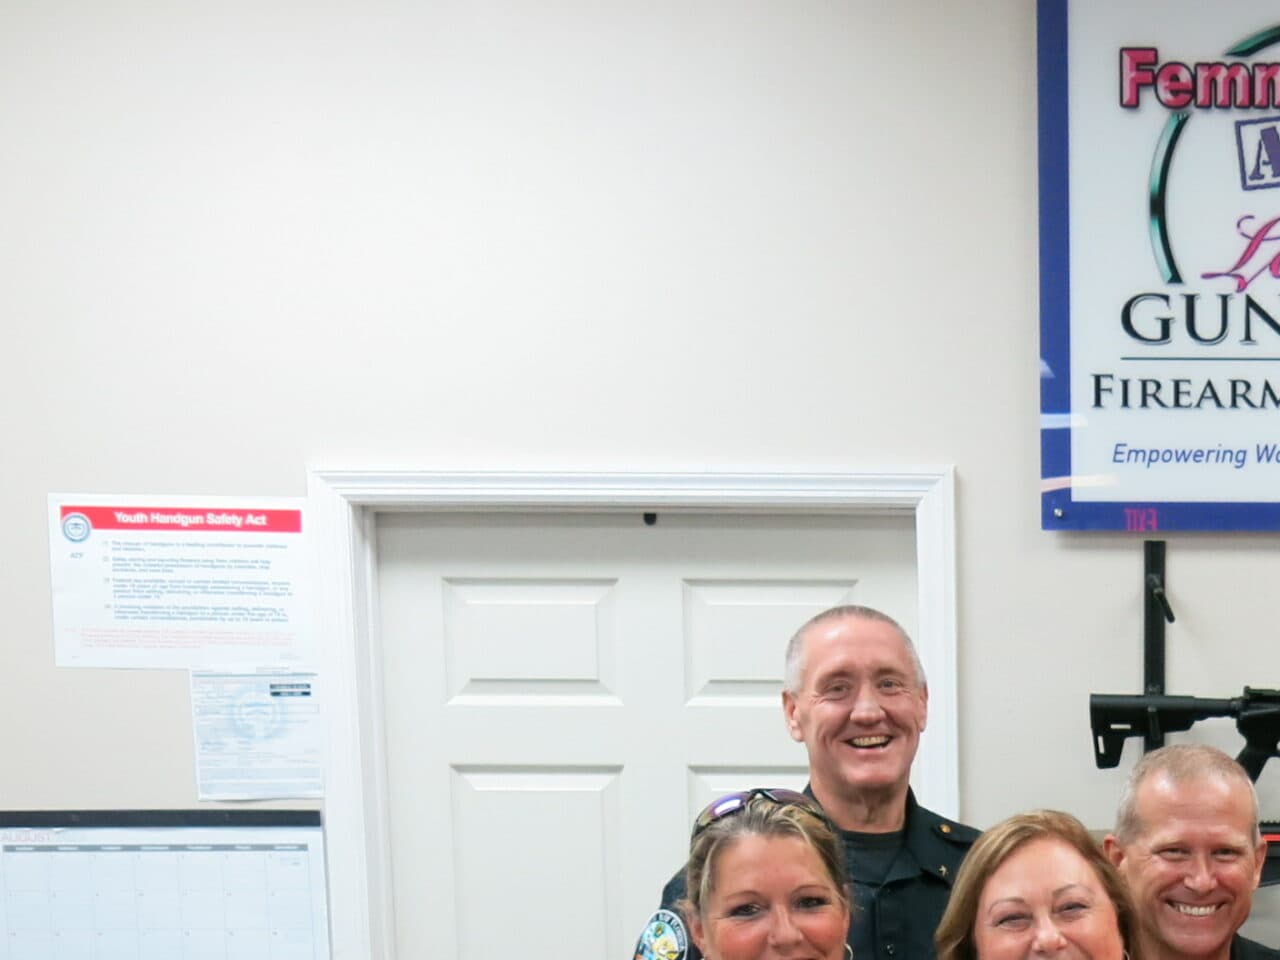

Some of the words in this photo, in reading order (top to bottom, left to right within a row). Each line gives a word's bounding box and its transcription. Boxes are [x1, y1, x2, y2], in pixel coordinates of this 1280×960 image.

[1112, 443, 1247, 469] Empowering
[114, 511, 148, 524] Youth
[150, 512, 204, 526] Handgun
[207, 513, 243, 527] Safety
[245, 513, 267, 526] Act
